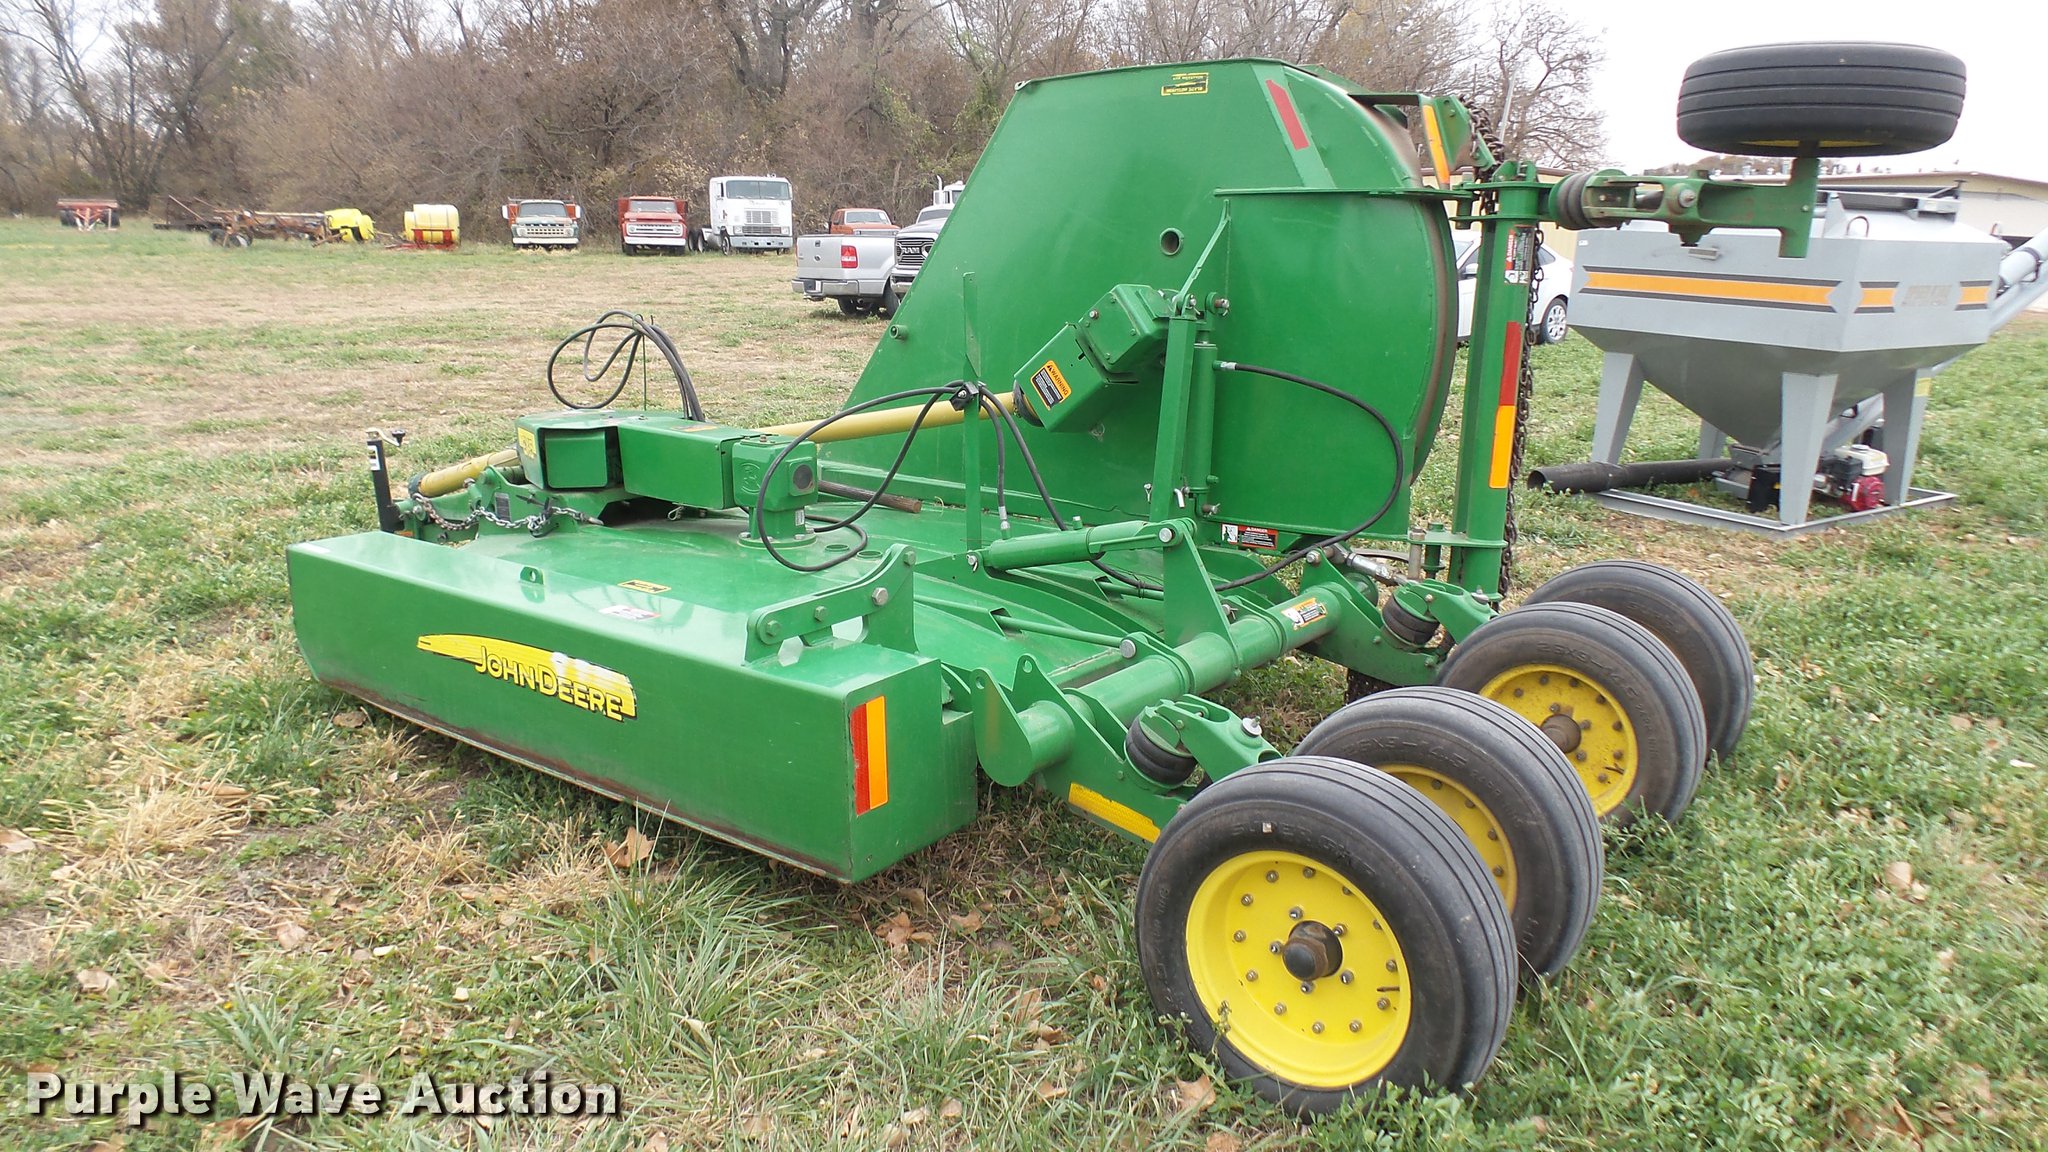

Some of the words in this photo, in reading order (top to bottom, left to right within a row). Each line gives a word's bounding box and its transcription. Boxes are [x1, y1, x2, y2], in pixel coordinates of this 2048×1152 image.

[1051, 369, 1069, 396] WARNING
[474, 645, 536, 690] JOHN
[537, 663, 625, 722] DEERE
